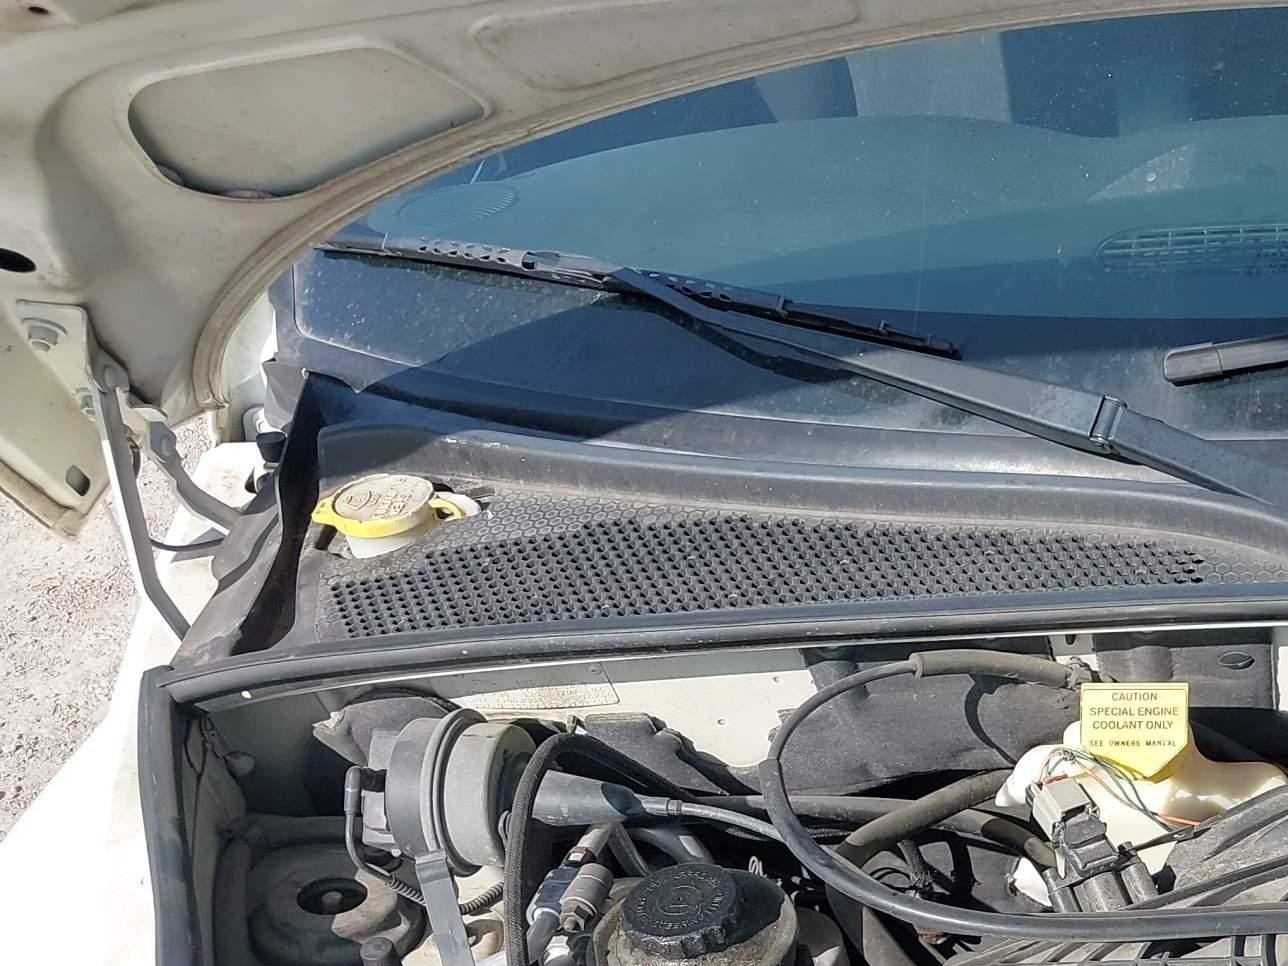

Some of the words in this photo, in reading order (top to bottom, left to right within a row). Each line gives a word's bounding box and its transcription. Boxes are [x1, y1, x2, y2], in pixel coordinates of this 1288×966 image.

[1111, 692, 1158, 702] CAUTION
[1090, 707, 1135, 716] SPECIAL
[1138, 706, 1180, 716] ENGINE
[1092, 720, 1144, 730] COOLANT
[1146, 720, 1174, 730] ONLY
